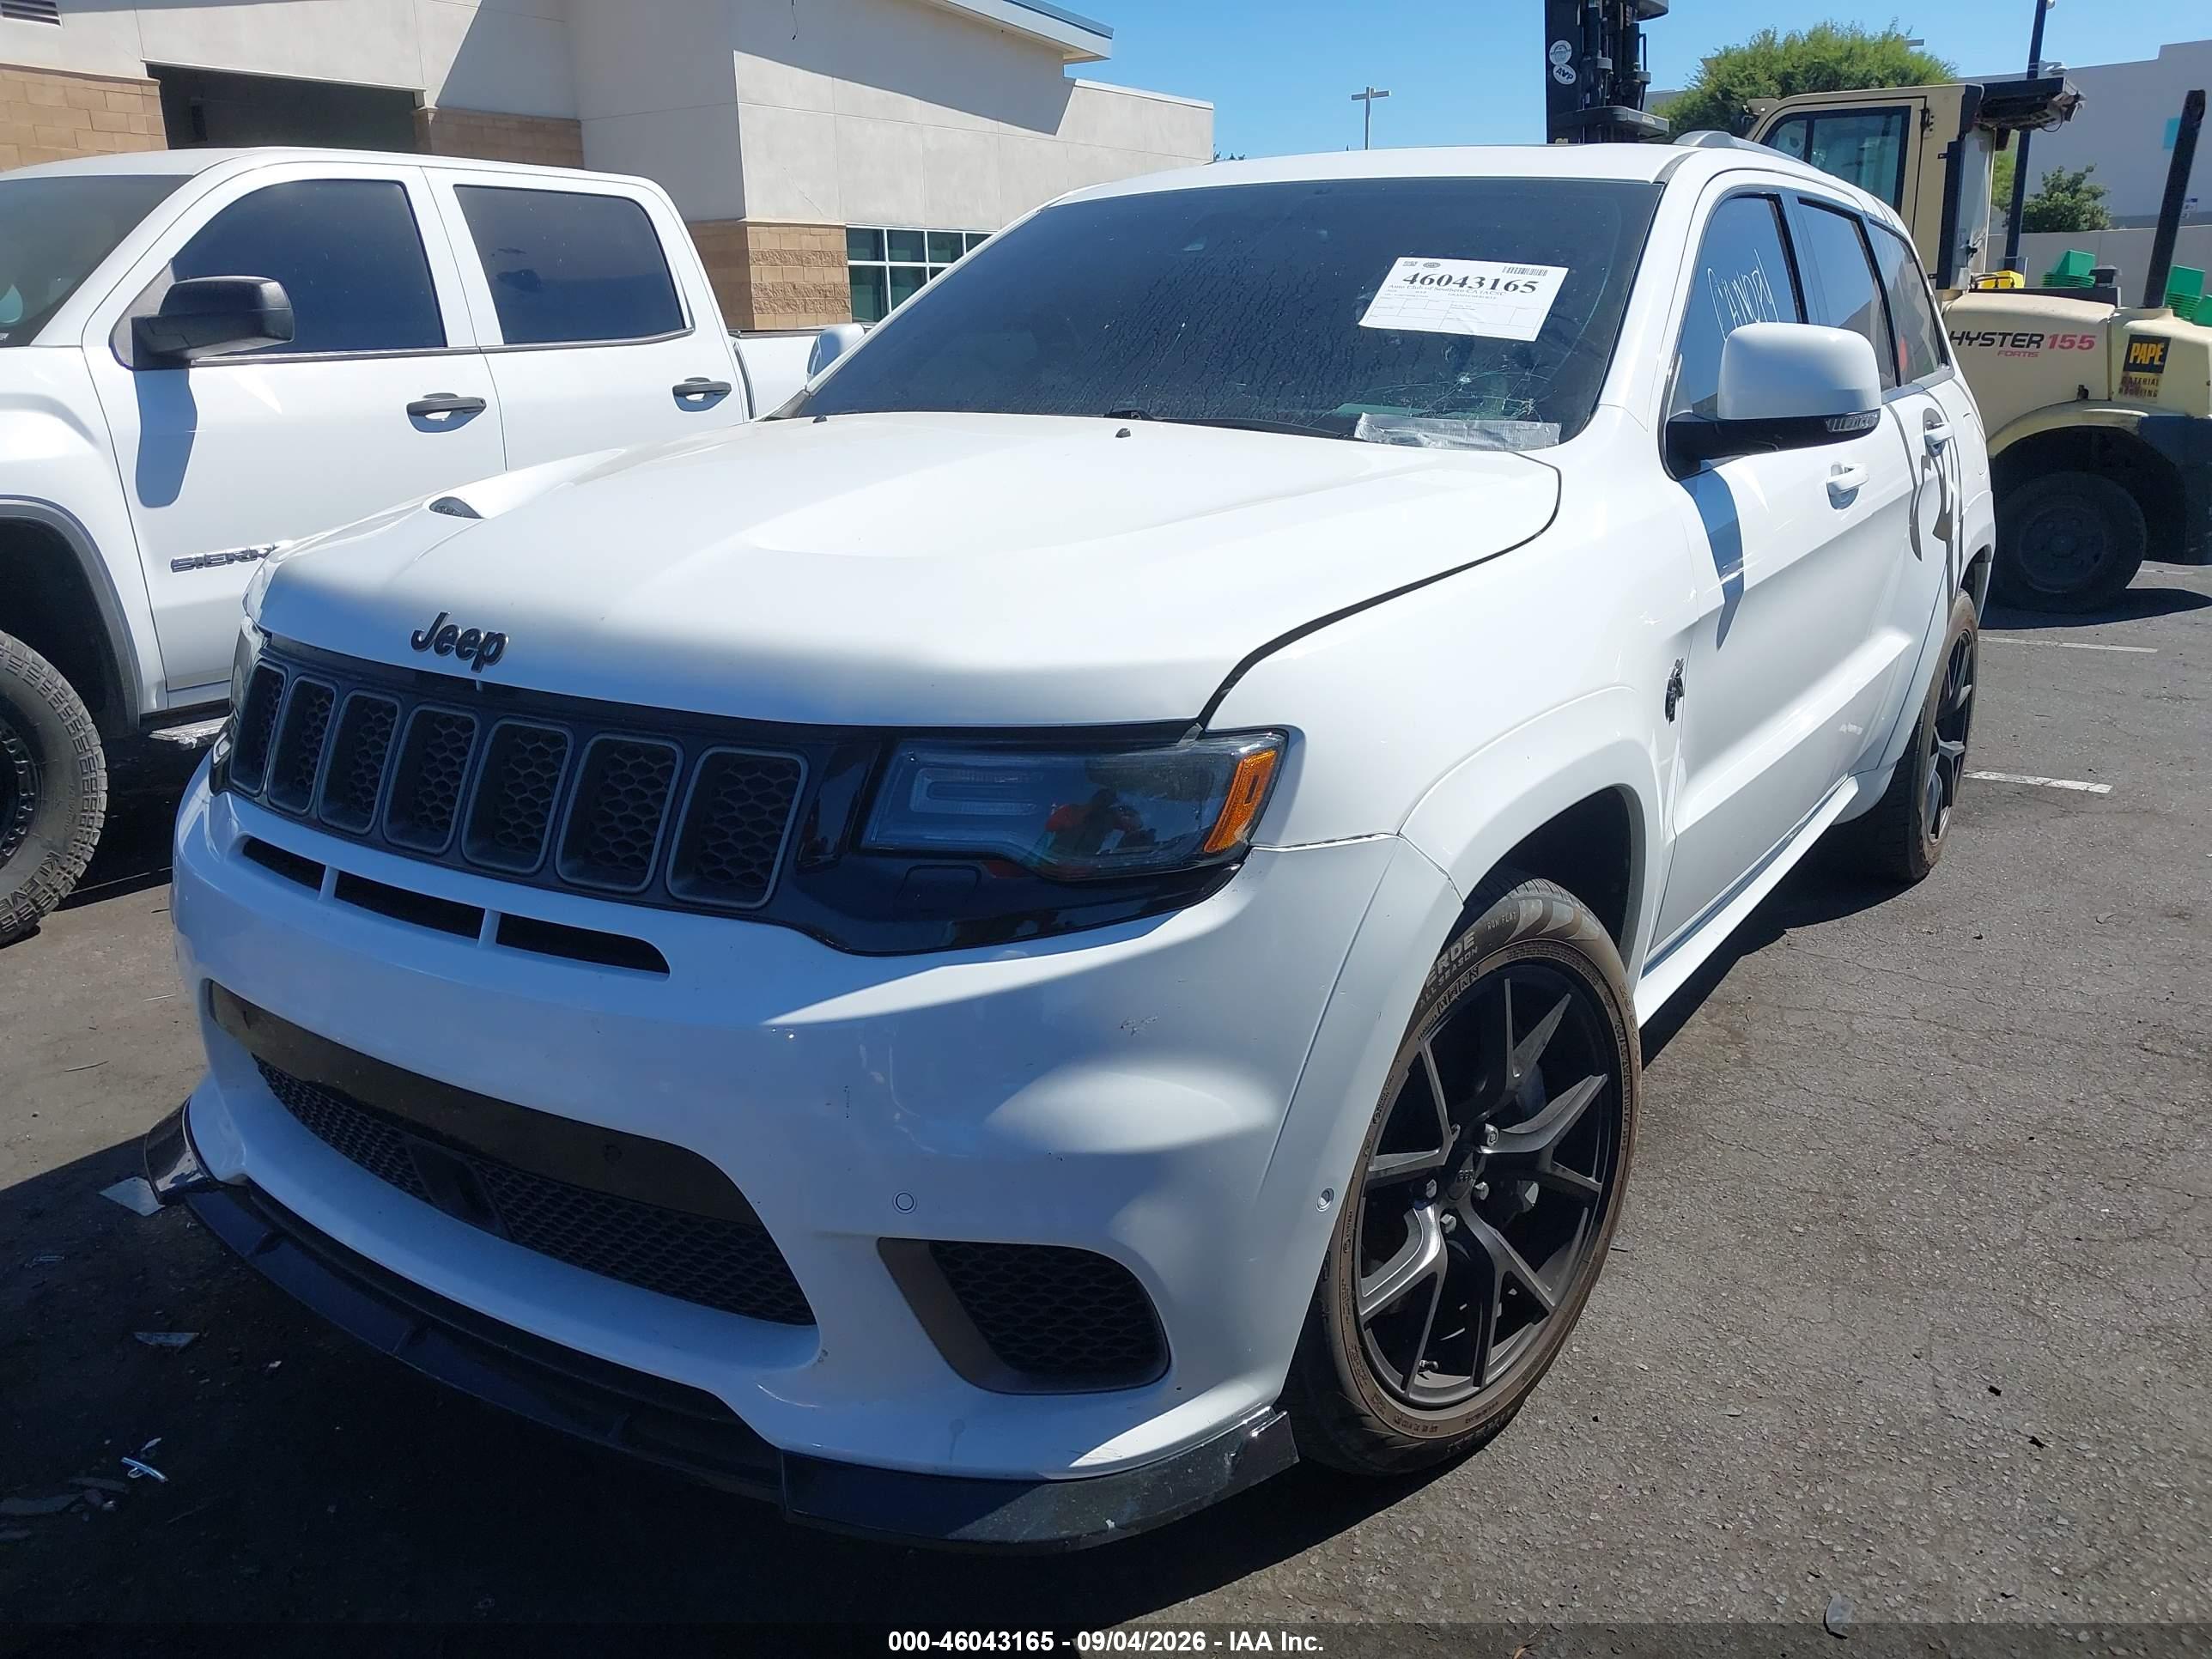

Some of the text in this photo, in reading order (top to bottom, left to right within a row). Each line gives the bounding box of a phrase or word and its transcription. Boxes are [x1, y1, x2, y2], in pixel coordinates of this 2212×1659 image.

[1402, 272, 1539, 294] 46043165
[1949, 331, 2096, 350] HYSTER 155
[171, 543, 277, 573] SIERR
[411, 611, 510, 674] Jeep
[1426, 931, 1476, 988] ERDE
[1437, 946, 1478, 986] SEASON
